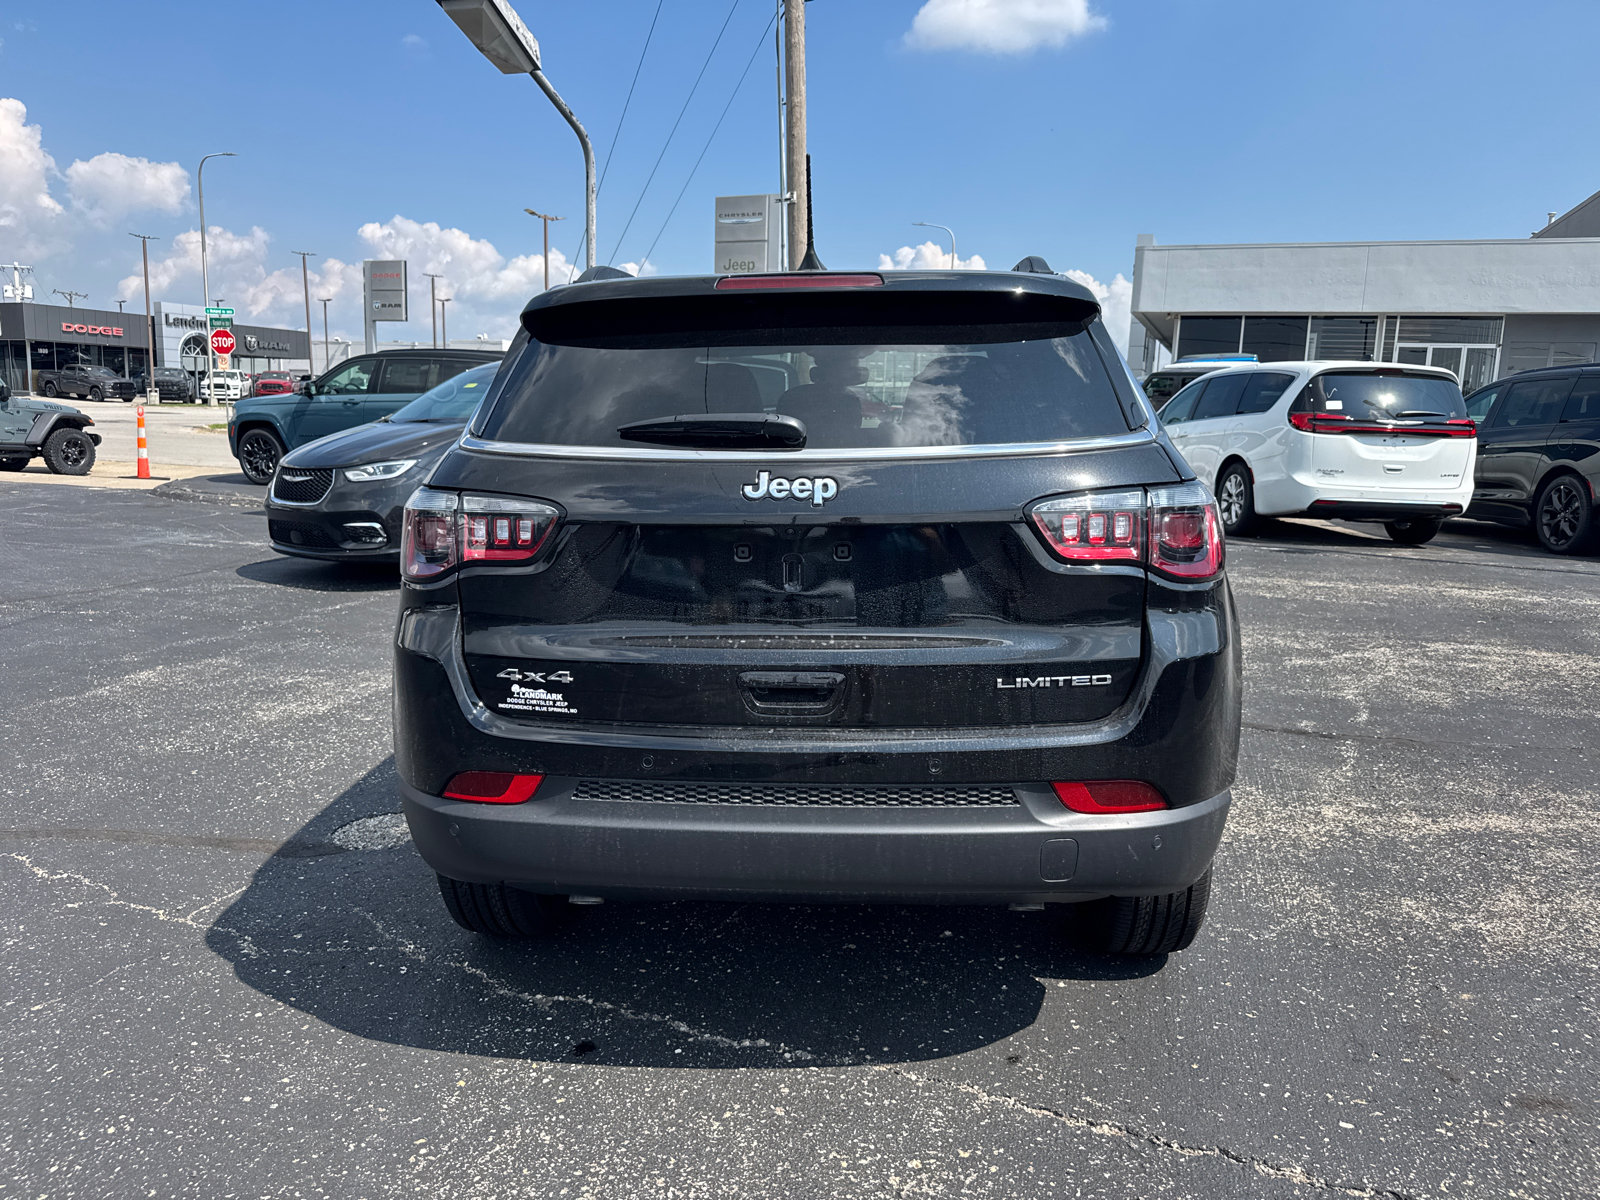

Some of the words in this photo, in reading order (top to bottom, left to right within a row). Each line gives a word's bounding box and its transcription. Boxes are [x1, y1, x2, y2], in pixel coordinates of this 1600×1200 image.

[723, 258, 756, 273] Jeep
[165, 313, 207, 329] Landm
[62, 322, 124, 336] DODGE
[212, 337, 234, 348] STOP
[742, 470, 838, 506] Jeep
[496, 668, 574, 683] 4x4
[997, 674, 1112, 688] LIMITED
[520, 691, 563, 701] LANDMARK
